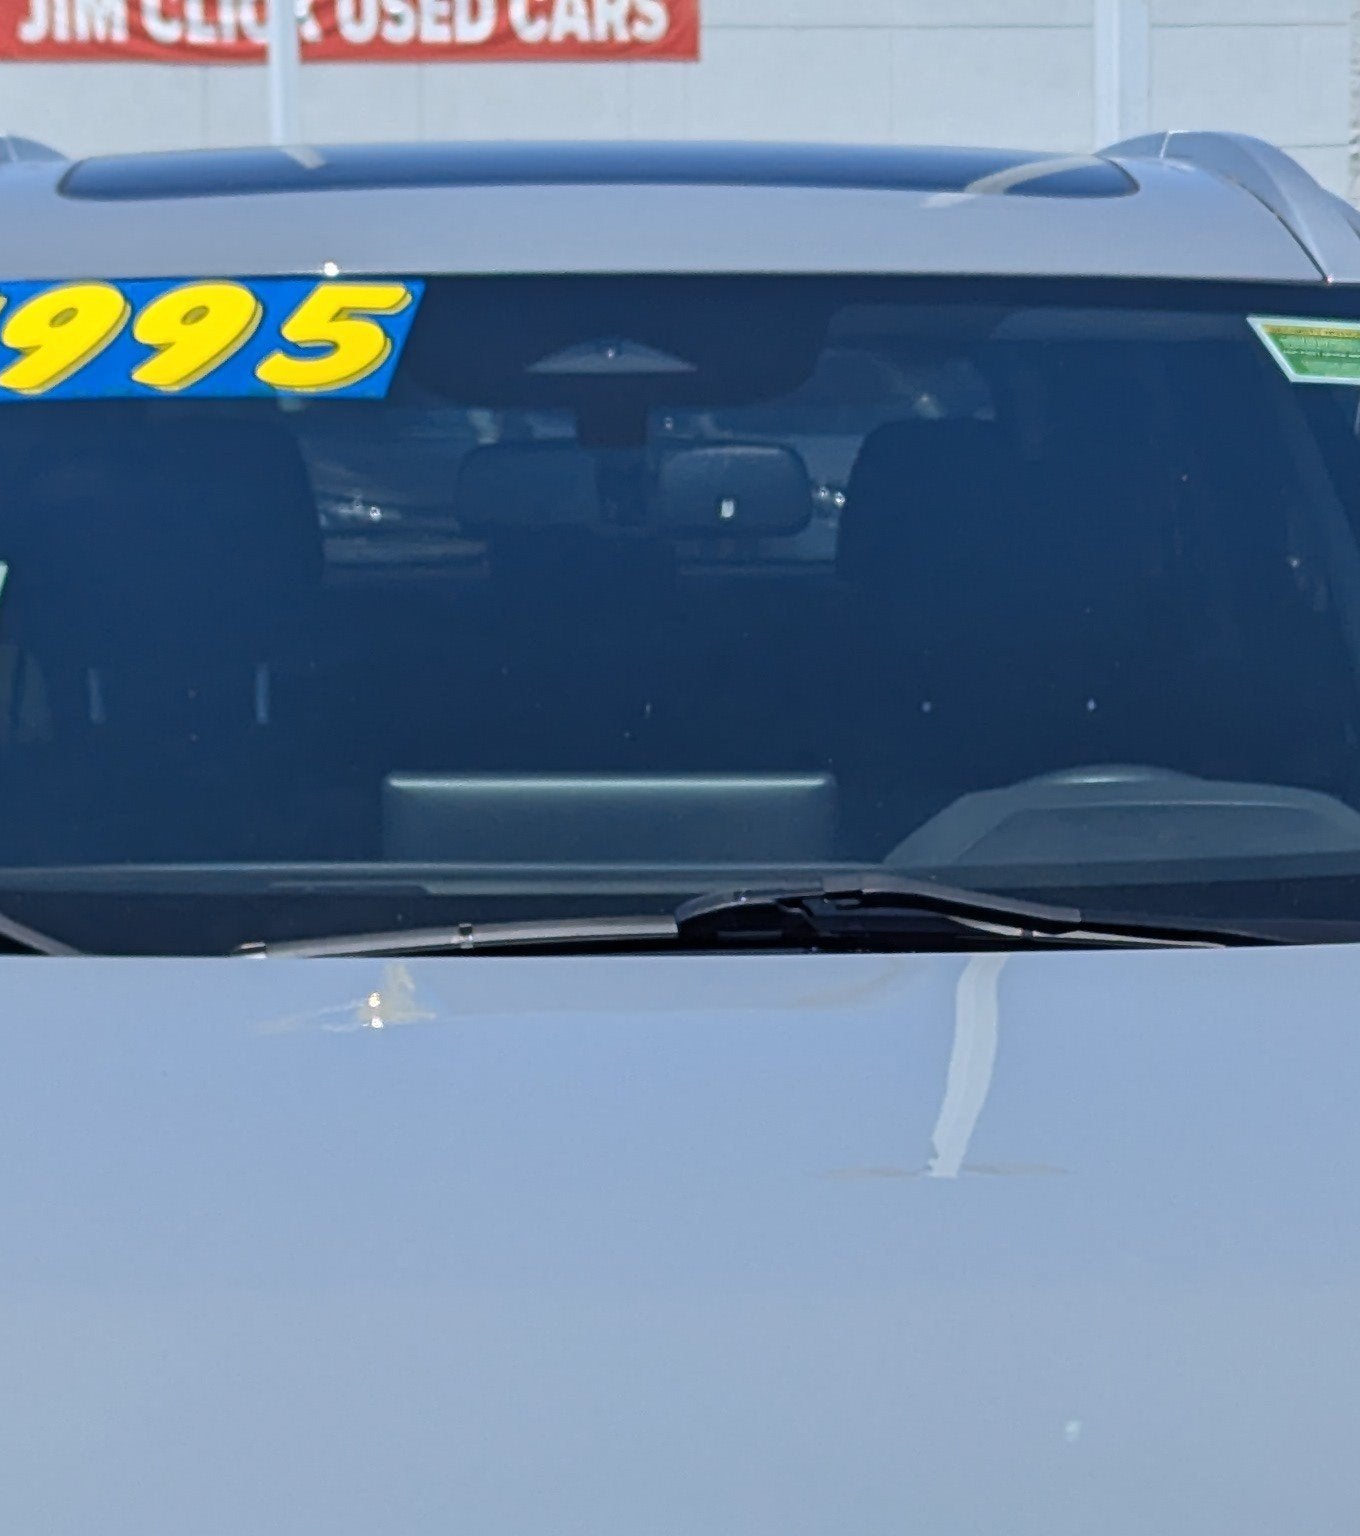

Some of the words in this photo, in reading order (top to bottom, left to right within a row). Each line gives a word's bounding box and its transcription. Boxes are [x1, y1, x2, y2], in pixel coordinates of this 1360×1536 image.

[16, 0, 130, 44] JIM
[334, 0, 499, 45] USED
[508, 0, 670, 44] CARS
